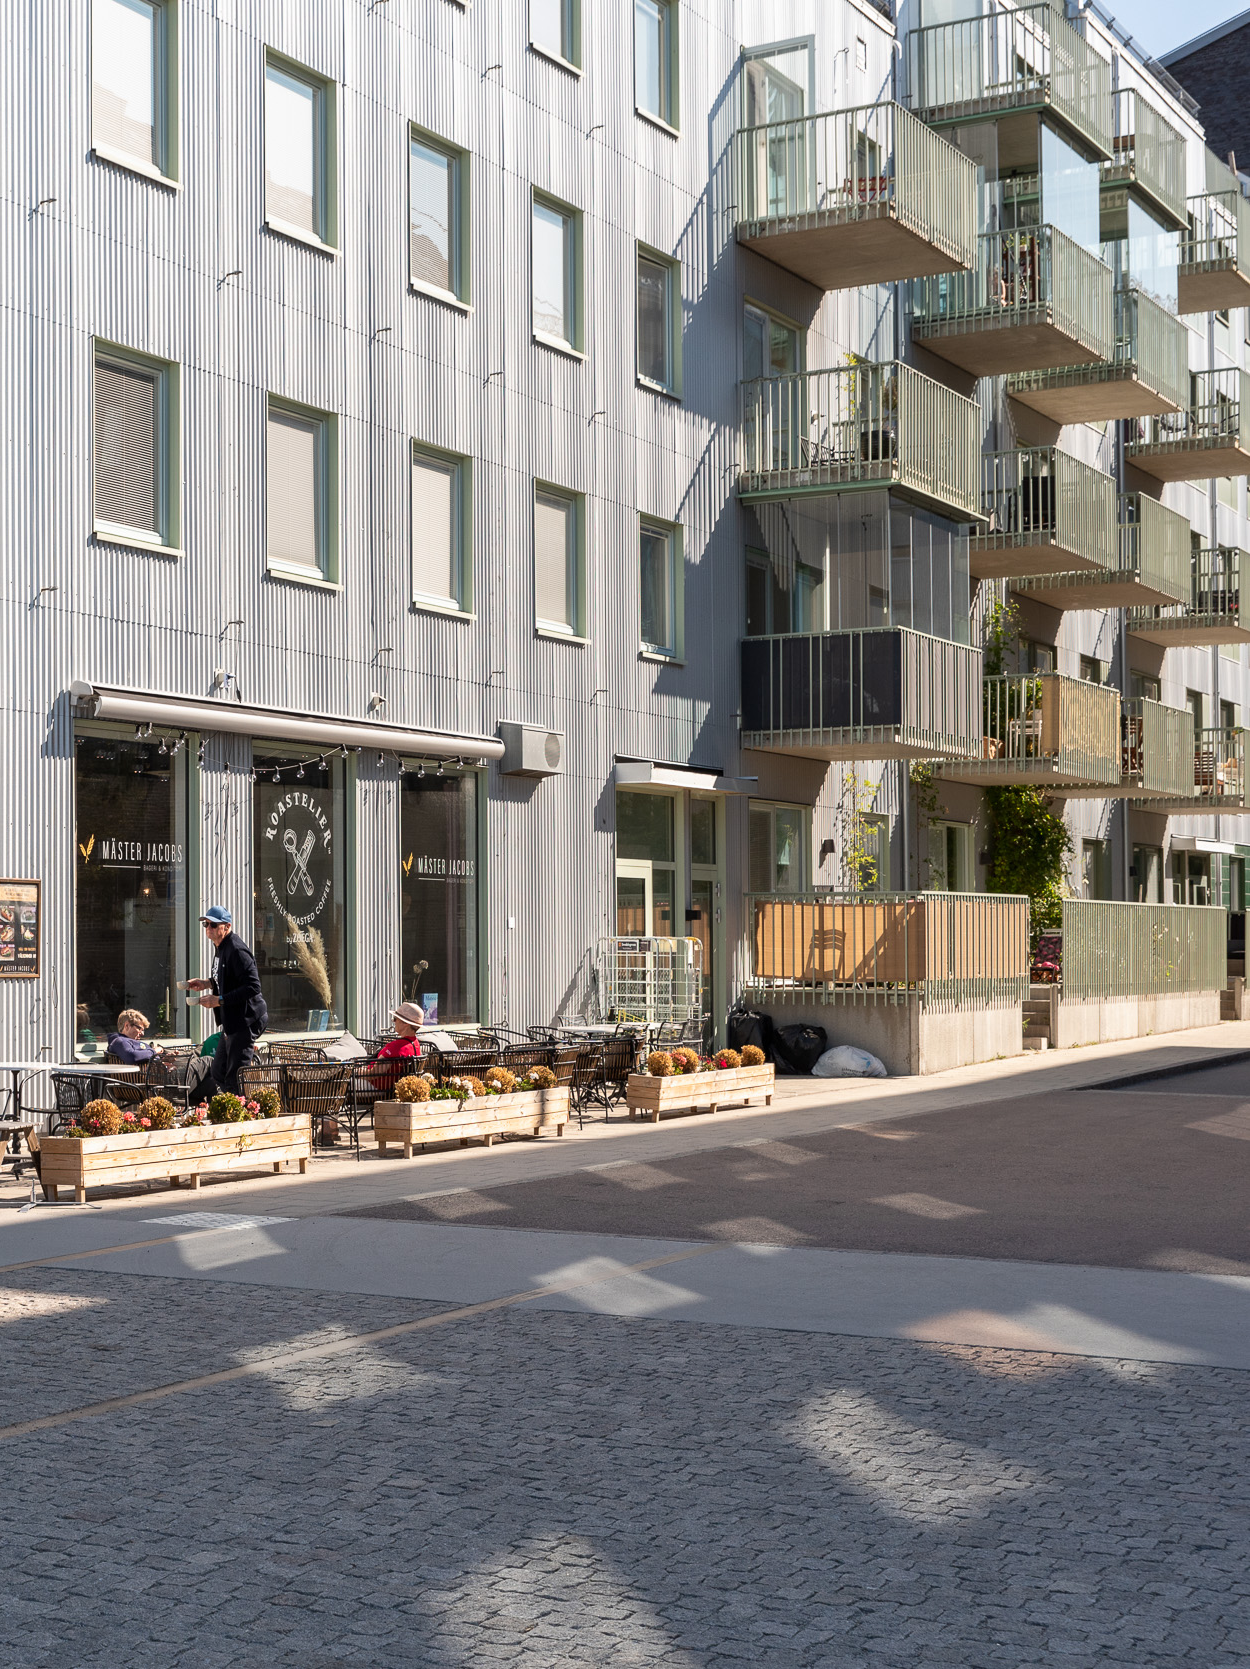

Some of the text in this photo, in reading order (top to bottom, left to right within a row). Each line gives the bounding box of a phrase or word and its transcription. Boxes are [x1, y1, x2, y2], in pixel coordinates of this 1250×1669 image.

[265, 792, 332, 848] ROASTELIER
[102, 837, 182, 863] MÄSTER JACOBS
[418, 855, 475, 876] MÄSTER JACOBS
[267, 877, 332, 926] FRESHLY ROASTED COFFEE
[286, 936, 292, 945] by
